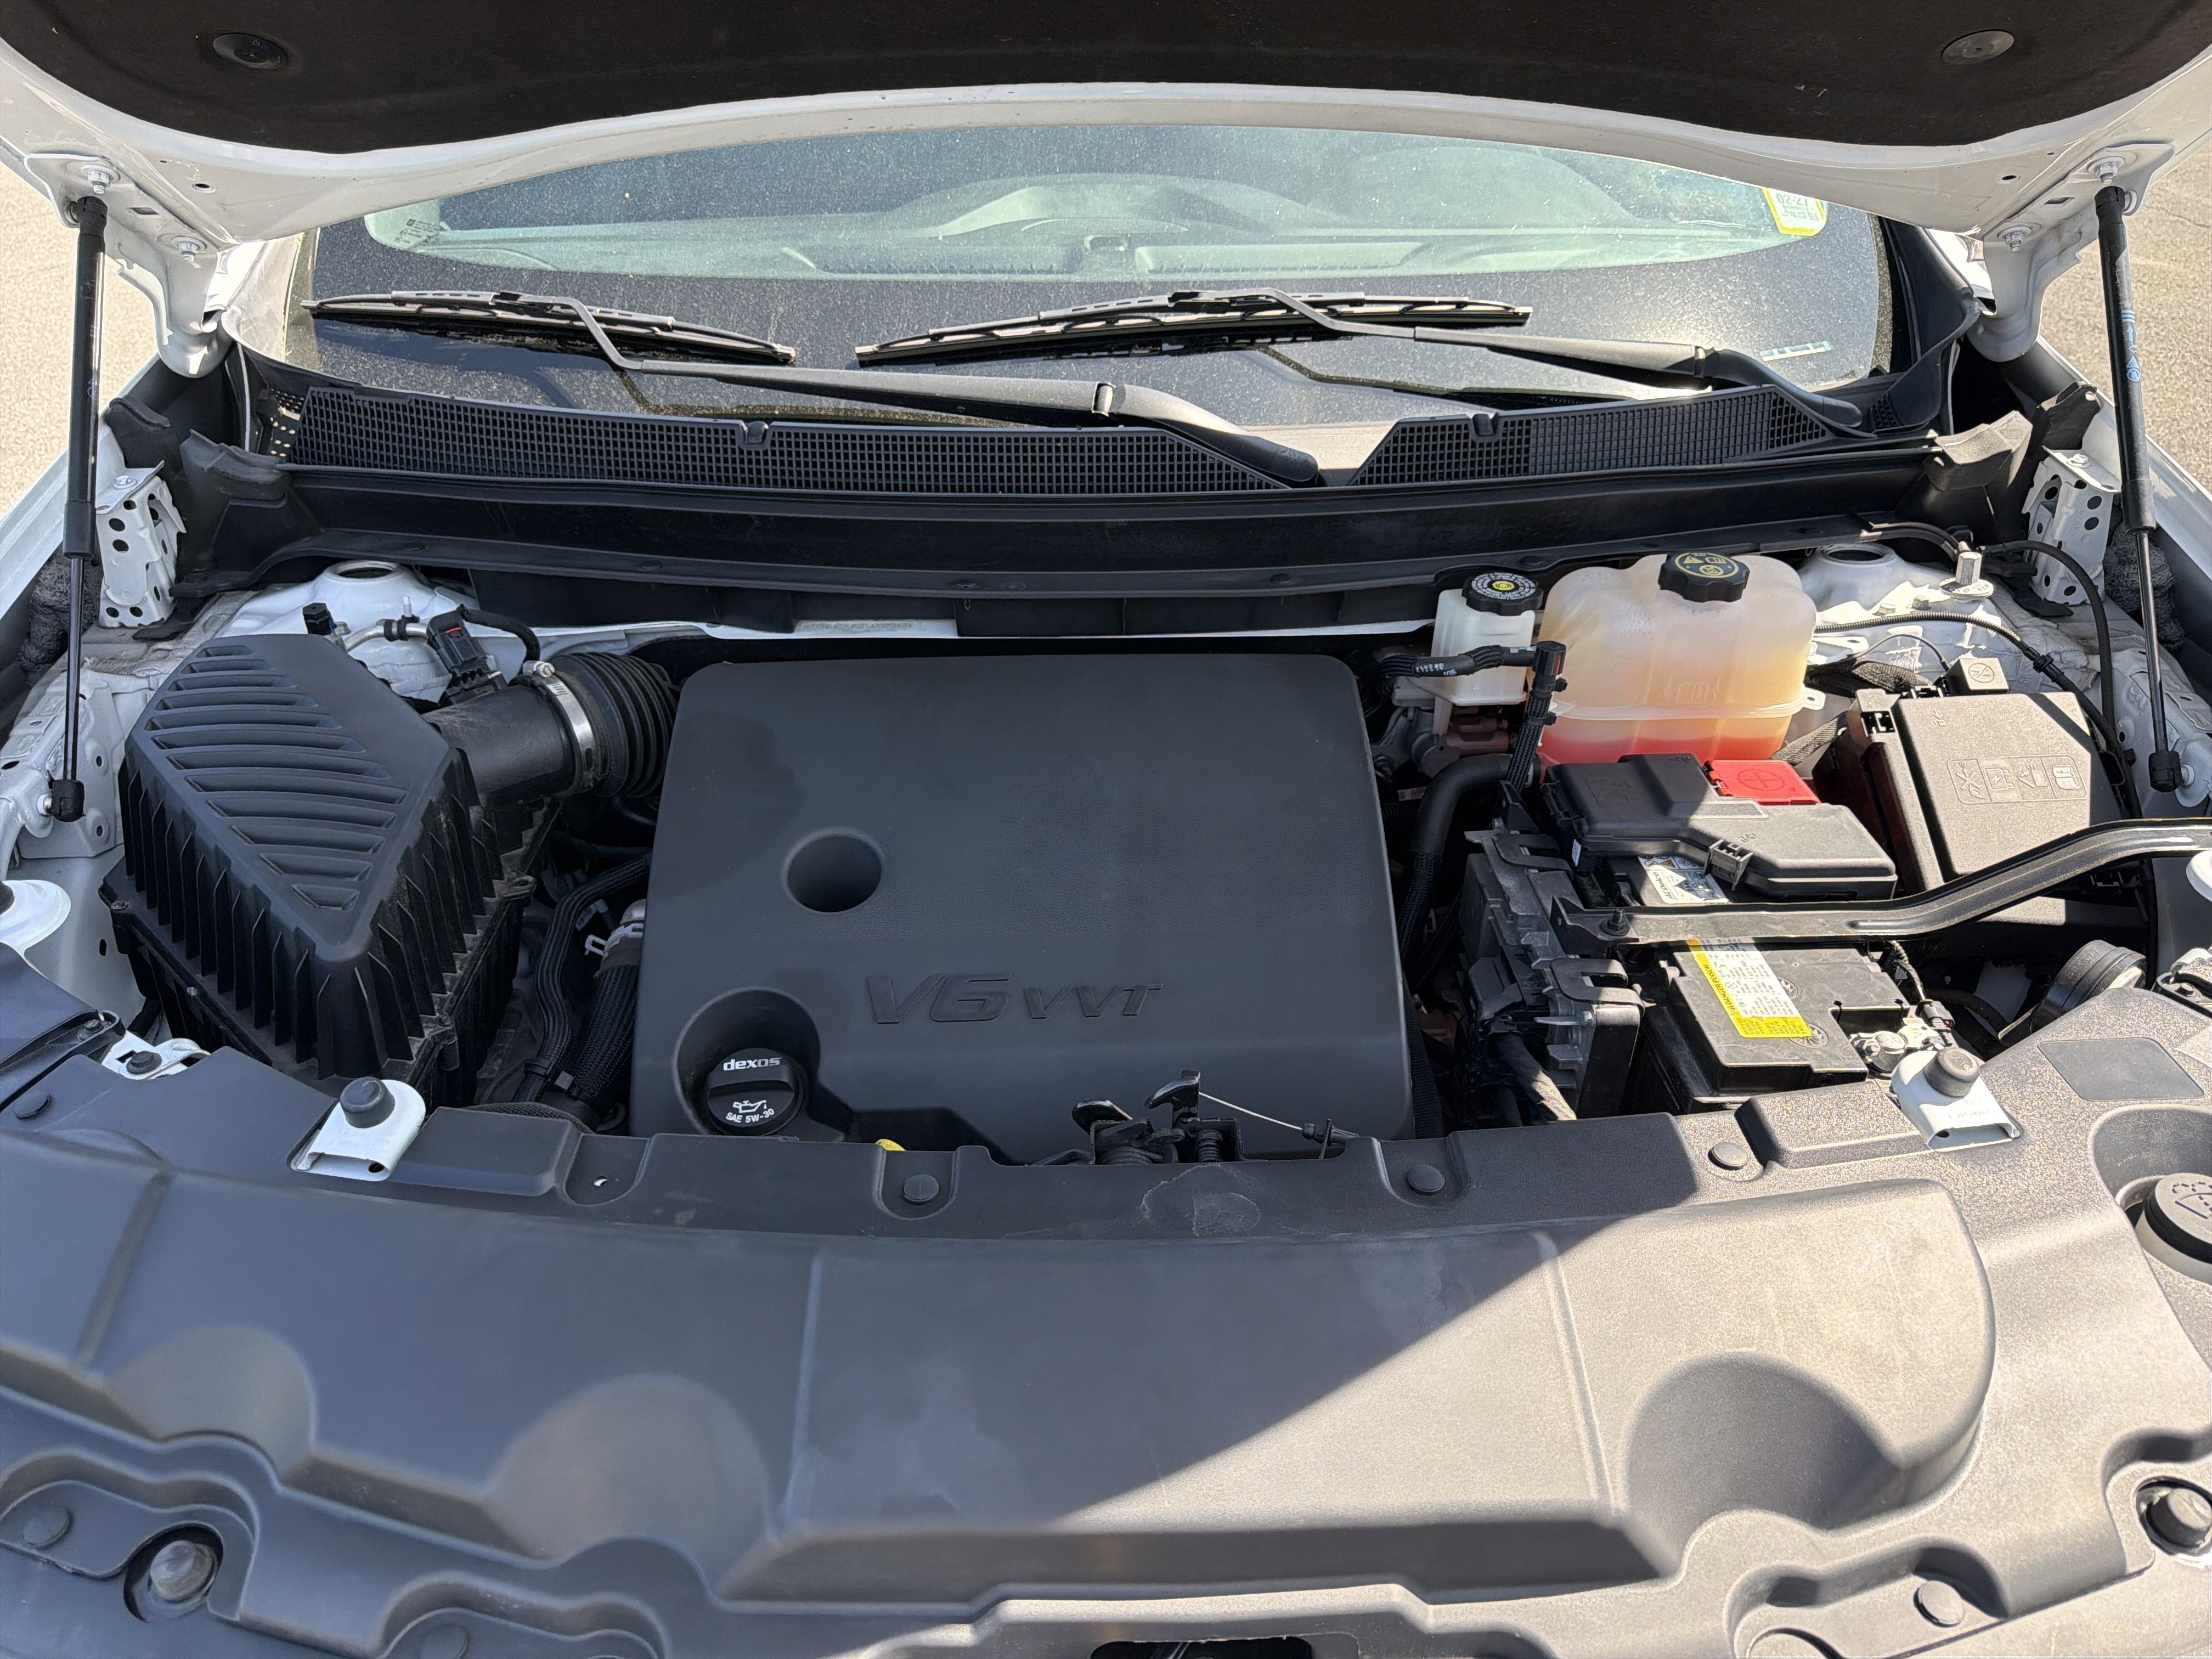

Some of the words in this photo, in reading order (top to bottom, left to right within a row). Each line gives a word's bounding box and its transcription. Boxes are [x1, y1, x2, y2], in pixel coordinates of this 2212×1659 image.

[866, 972, 1013, 1024] V6
[1023, 984, 1164, 1019] VVT
[723, 1057, 782, 1071] dexos
[725, 1112, 743, 1123] SAE
[745, 1108, 775, 1124] 5W-30
